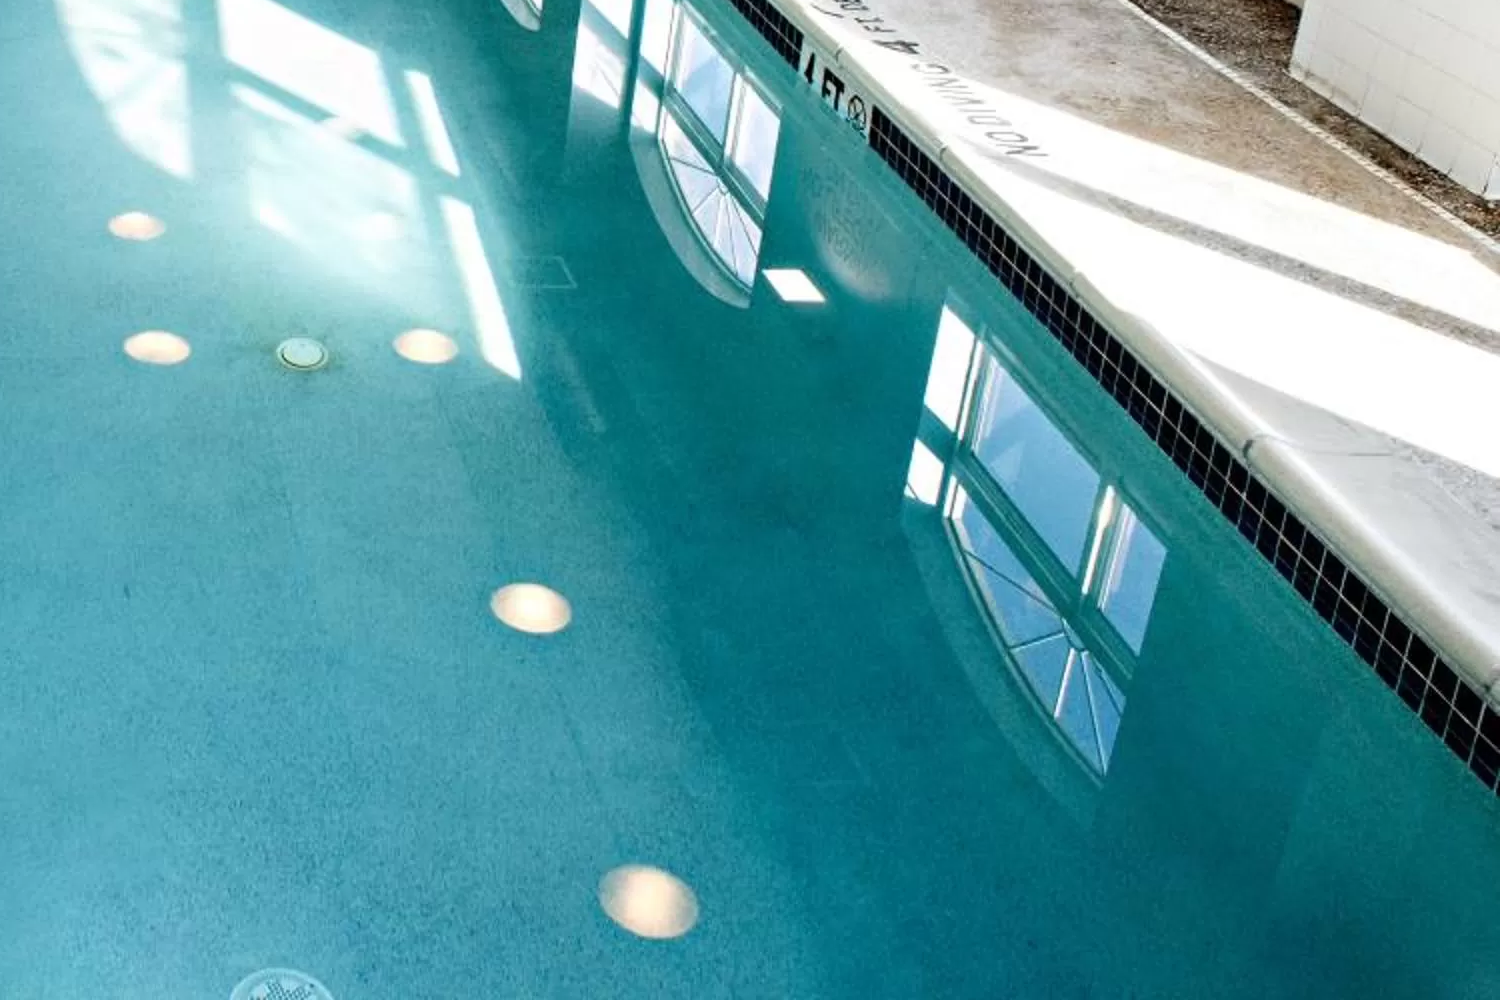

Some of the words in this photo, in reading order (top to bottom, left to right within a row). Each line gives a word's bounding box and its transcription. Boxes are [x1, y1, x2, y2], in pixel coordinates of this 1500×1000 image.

[822, 67, 845, 112] FT
[911, 63, 1013, 126] DIVING
[984, 131, 1049, 157] NO
